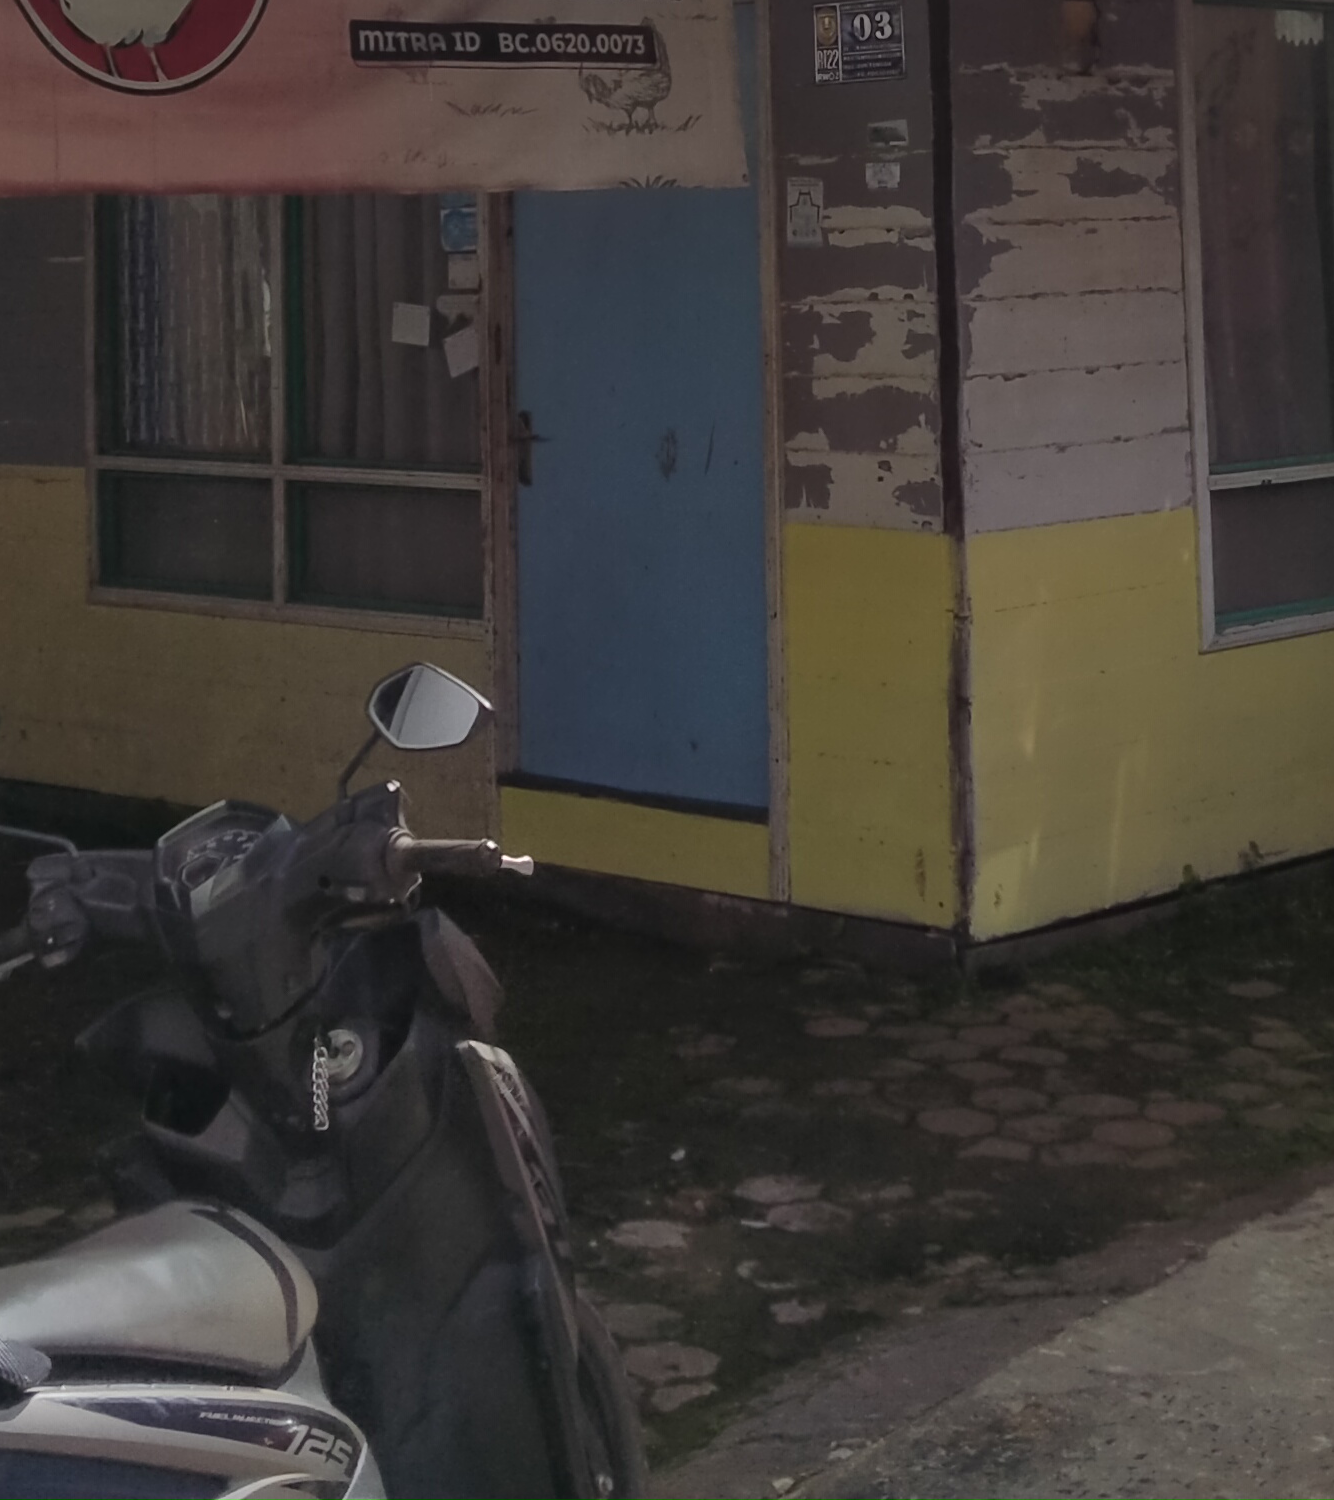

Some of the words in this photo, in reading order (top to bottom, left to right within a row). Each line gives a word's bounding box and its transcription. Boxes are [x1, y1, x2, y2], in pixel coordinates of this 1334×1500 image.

[853, 10, 893, 41] 03
[358, 28, 447, 53] MITRA
[453, 31, 481, 53] ID
[498, 32, 646, 56] BC.0620.0073
[285, 1424, 355, 1479] 125
